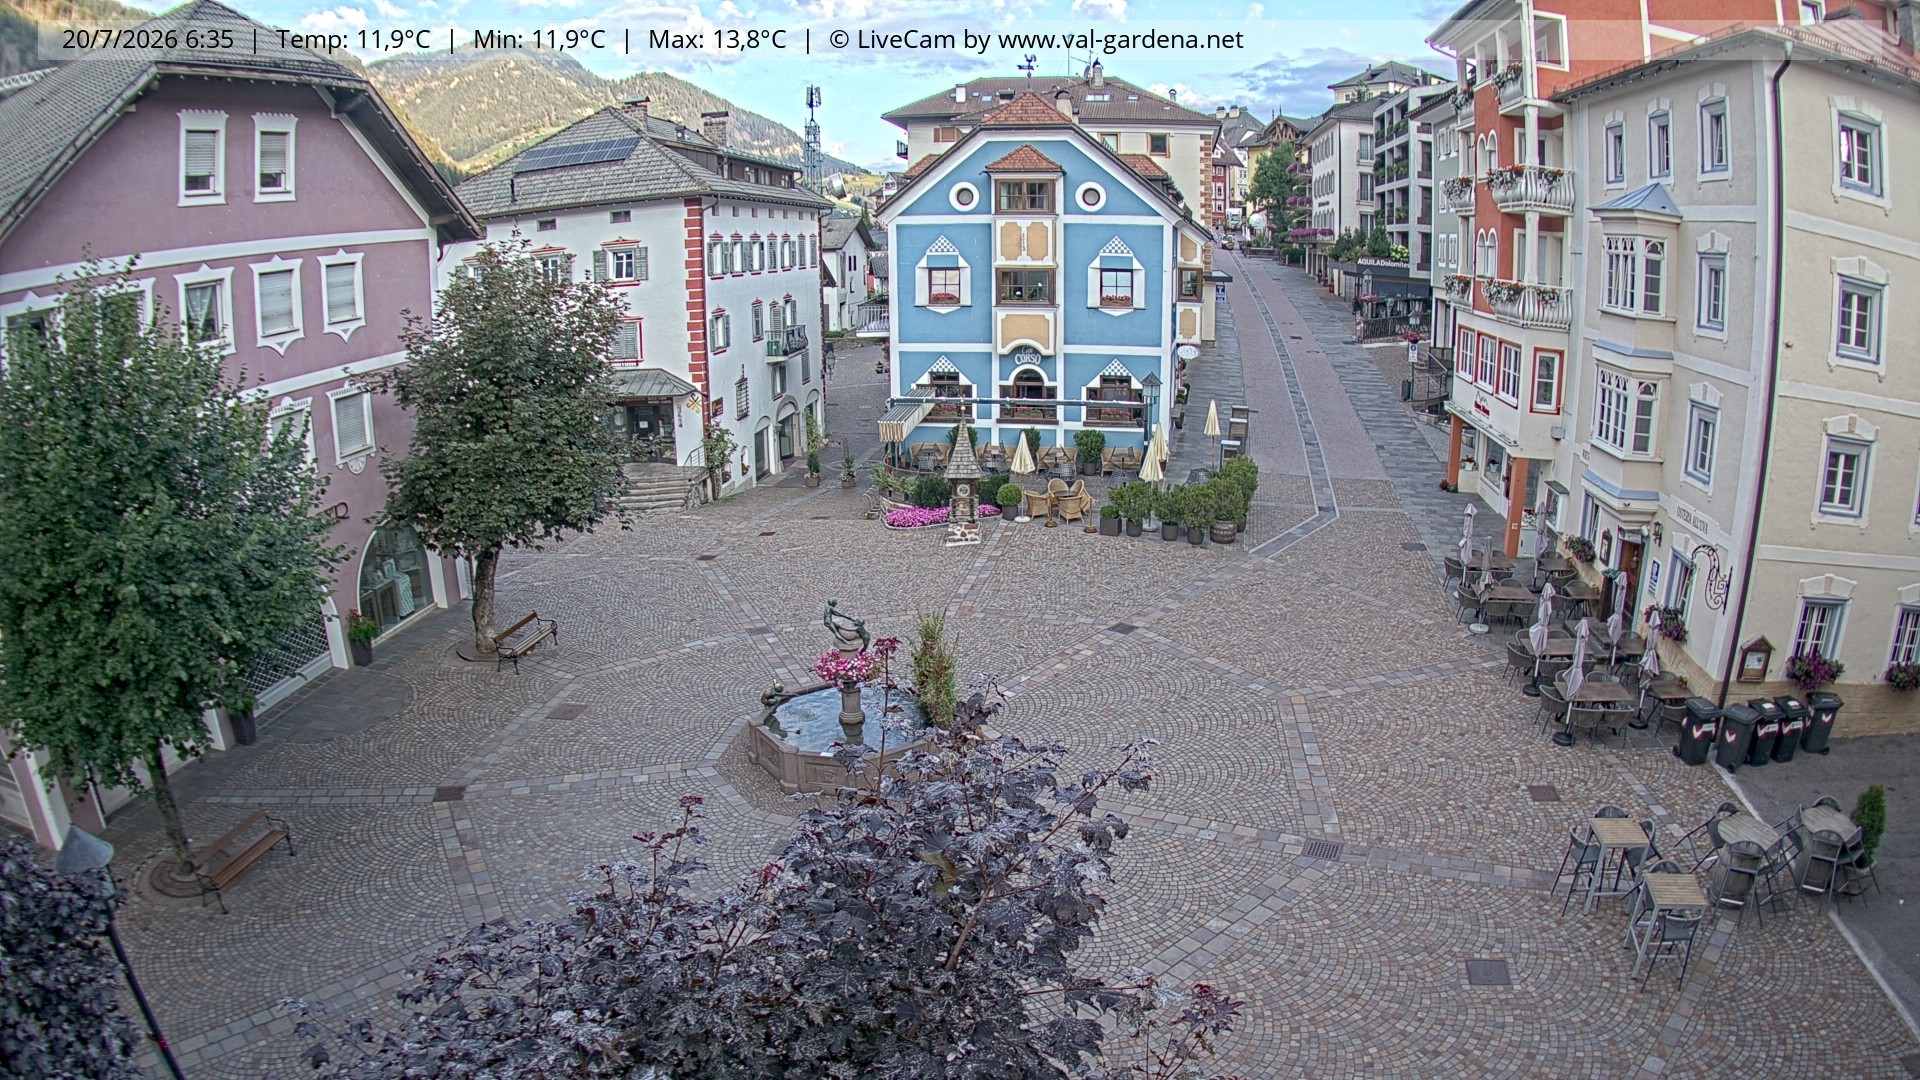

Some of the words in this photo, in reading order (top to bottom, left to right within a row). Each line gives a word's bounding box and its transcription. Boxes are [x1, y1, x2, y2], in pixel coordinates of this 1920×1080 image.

[1357, 258, 1381, 267] AQUILA
[1380, 260, 1410, 269] Dolomites
[1014, 353, 1042, 365] CORSO
[1676, 506, 1692, 525] OSTERIA
